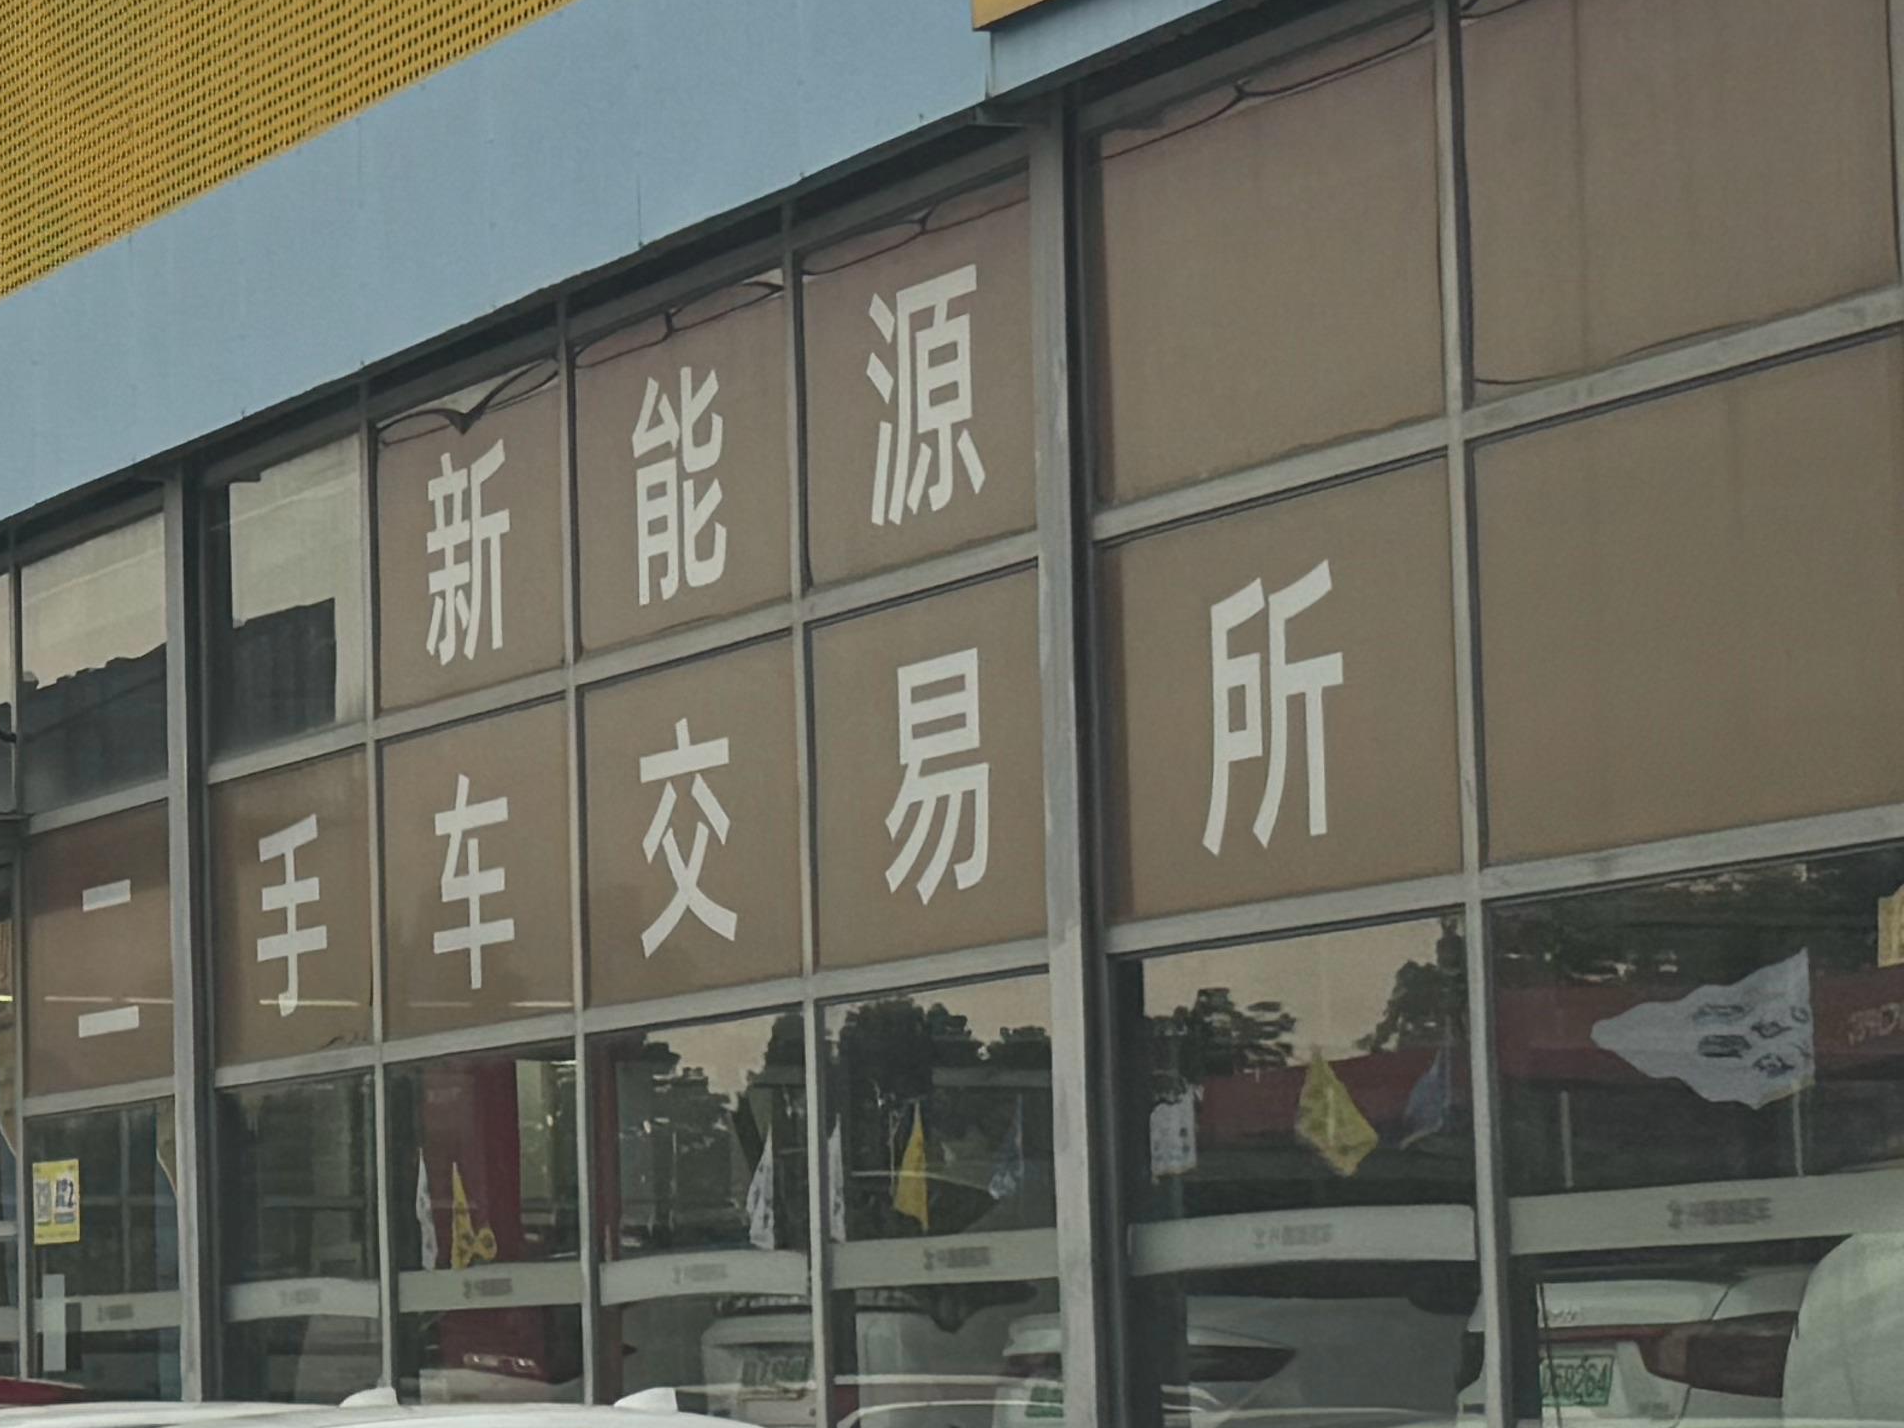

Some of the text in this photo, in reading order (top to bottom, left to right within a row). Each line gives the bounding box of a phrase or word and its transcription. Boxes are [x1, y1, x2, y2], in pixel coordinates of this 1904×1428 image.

[427, 263, 987, 667] 新能源
[78, 560, 1345, 1039] 二手车交易所
